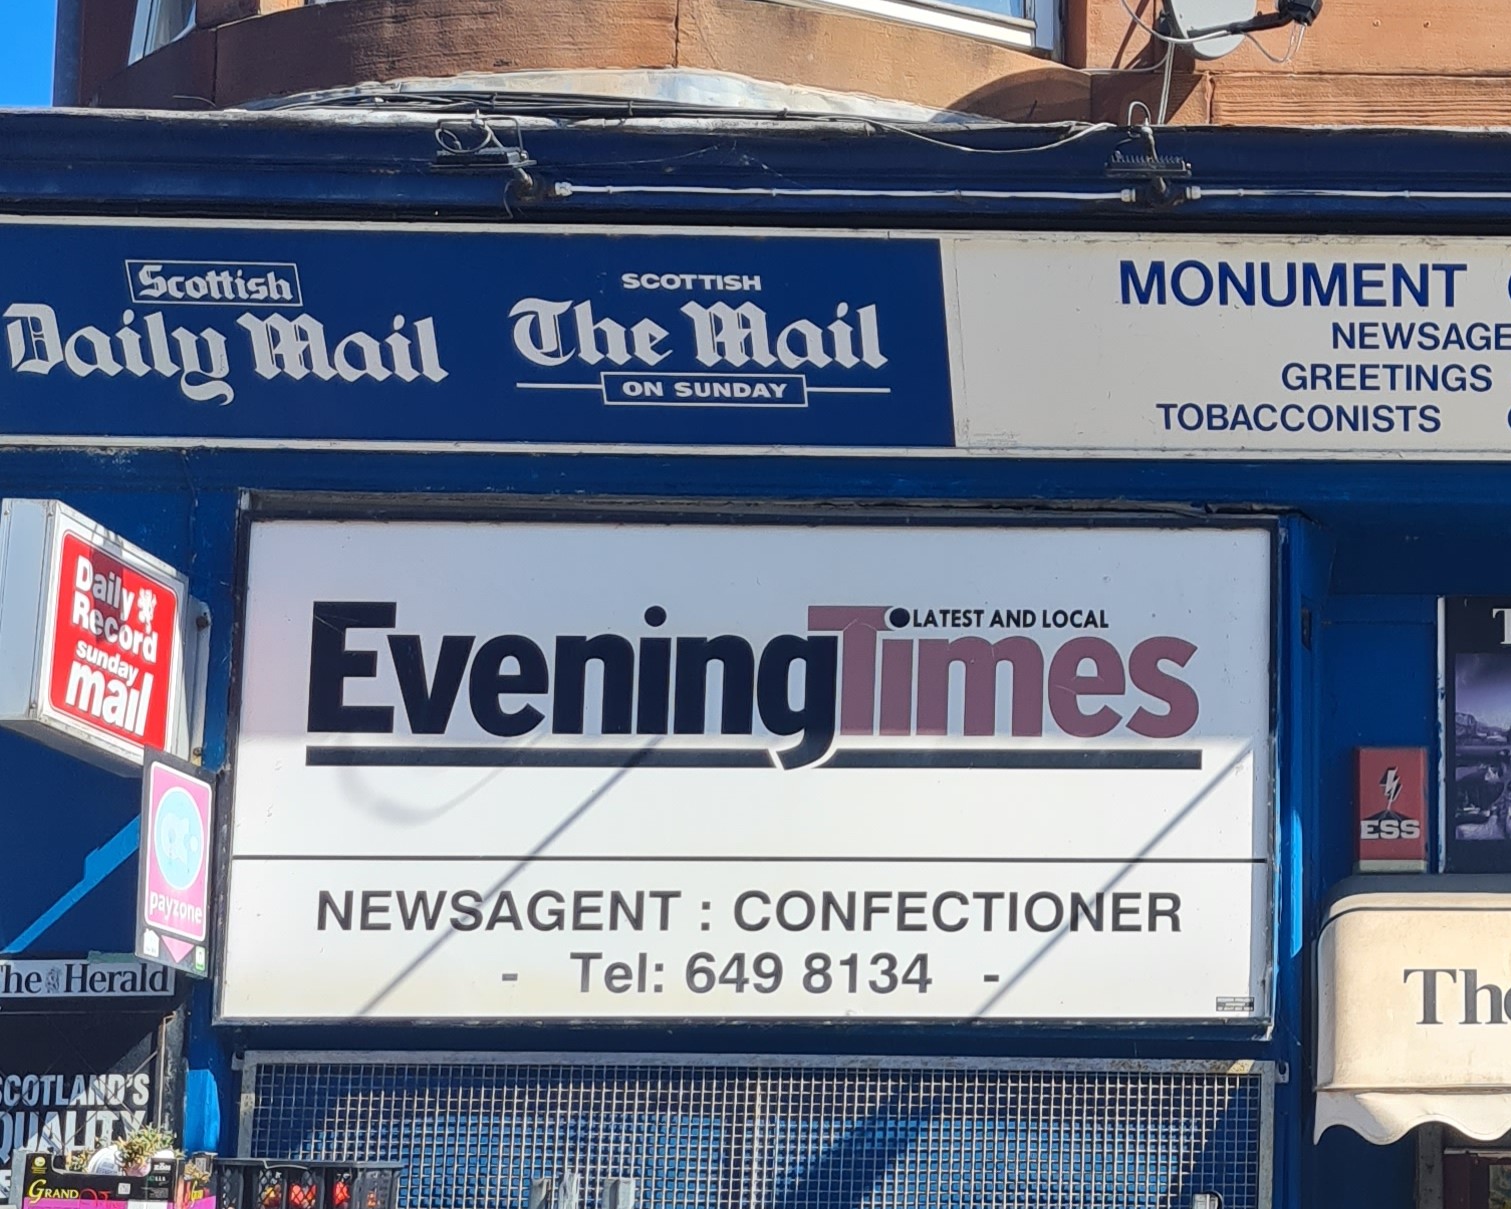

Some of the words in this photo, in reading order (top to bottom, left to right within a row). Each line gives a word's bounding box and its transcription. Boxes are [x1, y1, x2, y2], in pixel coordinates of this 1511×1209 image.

[137, 264, 293, 302] Scottish
[622, 272, 762, 292] SCOTTISH
[1119, 259, 1468, 309] MONUMENT
[508, 297, 674, 367] The
[680, 301, 889, 370] Mail
[2, 303, 230, 405] Daily
[237, 312, 448, 383] Mail
[622, 380, 666, 399] ON
[674, 381, 788, 400] SUNDAY
[1281, 362, 1492, 393] GREETINGS
[1156, 402, 1442, 434] TOBACCONISTS
[75, 555, 135, 621] Daily
[72, 591, 158, 664] Record
[912, 609, 985, 629] LATEST
[989, 609, 1037, 629] AND
[1042, 609, 1108, 629] LOCAL
[75, 639, 139, 687] sunday
[65, 660, 154, 737] mail
[306, 601, 837, 771] Evening
[807, 606, 1199, 739] Times
[1360, 819, 1421, 840] ESS
[150, 891, 202, 924] payzone
[317, 889, 682, 932] NEWSAGENT
[700, 898, 713, 932] :
[733, 891, 1182, 933] CONFECTIONER
[0, 963, 42, 994] he
[64, 963, 169, 993] Herald
[571, 952, 666, 994] Tel:
[684, 952, 785, 995] 649
[802, 952, 932, 995] 8134
[0, 1073, 150, 1107] COTLAND'S
[29, 1179, 79, 1204] GRAND
